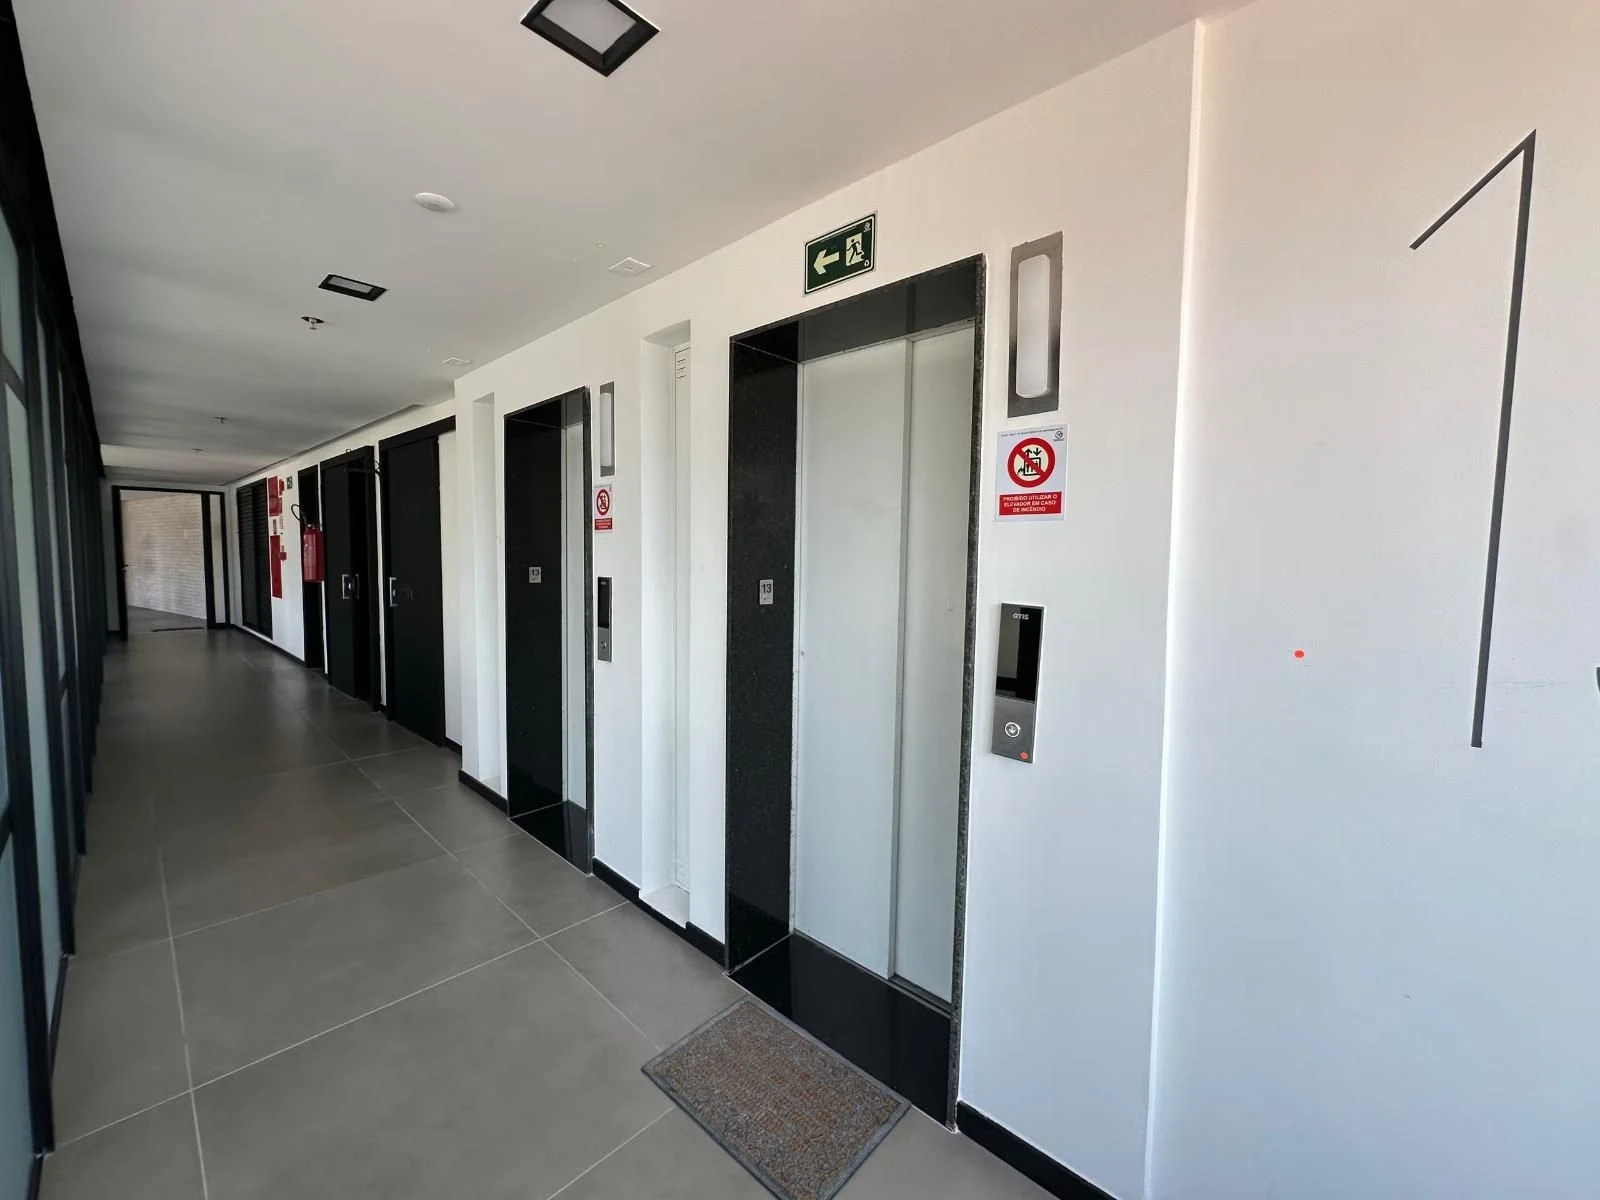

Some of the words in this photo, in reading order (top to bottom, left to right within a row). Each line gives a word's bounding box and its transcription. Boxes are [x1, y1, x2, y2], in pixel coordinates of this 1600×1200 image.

[1409, 129, 1600, 749] 1
[762, 583, 772, 594] 13
[1012, 612, 1029, 620] OTIS
